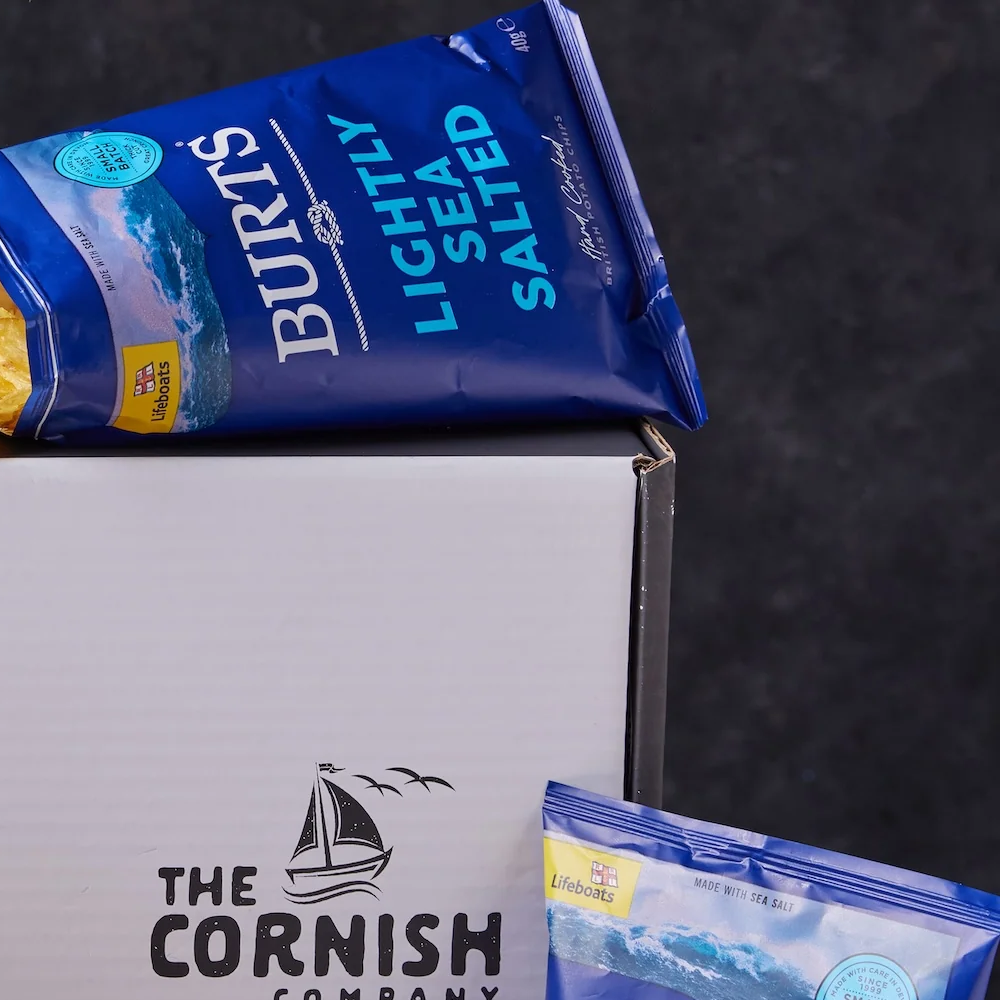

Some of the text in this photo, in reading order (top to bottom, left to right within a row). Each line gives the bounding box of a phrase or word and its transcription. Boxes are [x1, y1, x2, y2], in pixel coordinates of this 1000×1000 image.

[509, 31, 530, 52] 40g
[90, 144, 116, 173] SMALL
[101, 142, 130, 171] BATCH
[414, 156, 486, 264] SEA
[444, 105, 556, 311] SALTED
[541, 134, 602, 261] Hand Cooked
[554, 115, 613, 286] BRITISH POTATO CHIPS
[187, 126, 339, 363] BURTS
[327, 114, 458, 334] LIGHTLY
[69, 225, 116, 291] MADE WITH SEA SALT
[151, 361, 170, 422] Lifeboats
[158, 866, 257, 906] THE
[551, 873, 615, 903] Lifeboats
[693, 877, 795, 912] MADE WITH SEA SALT
[150, 912, 501, 978] CORNISH
[831, 977, 847, 997] MADE
[847, 967, 866, 978] WITH
[868, 967, 889, 979] CARE
[889, 977, 898, 986] IN
[857, 975, 888, 989] SINCE
[859, 983, 882, 995] 1999
